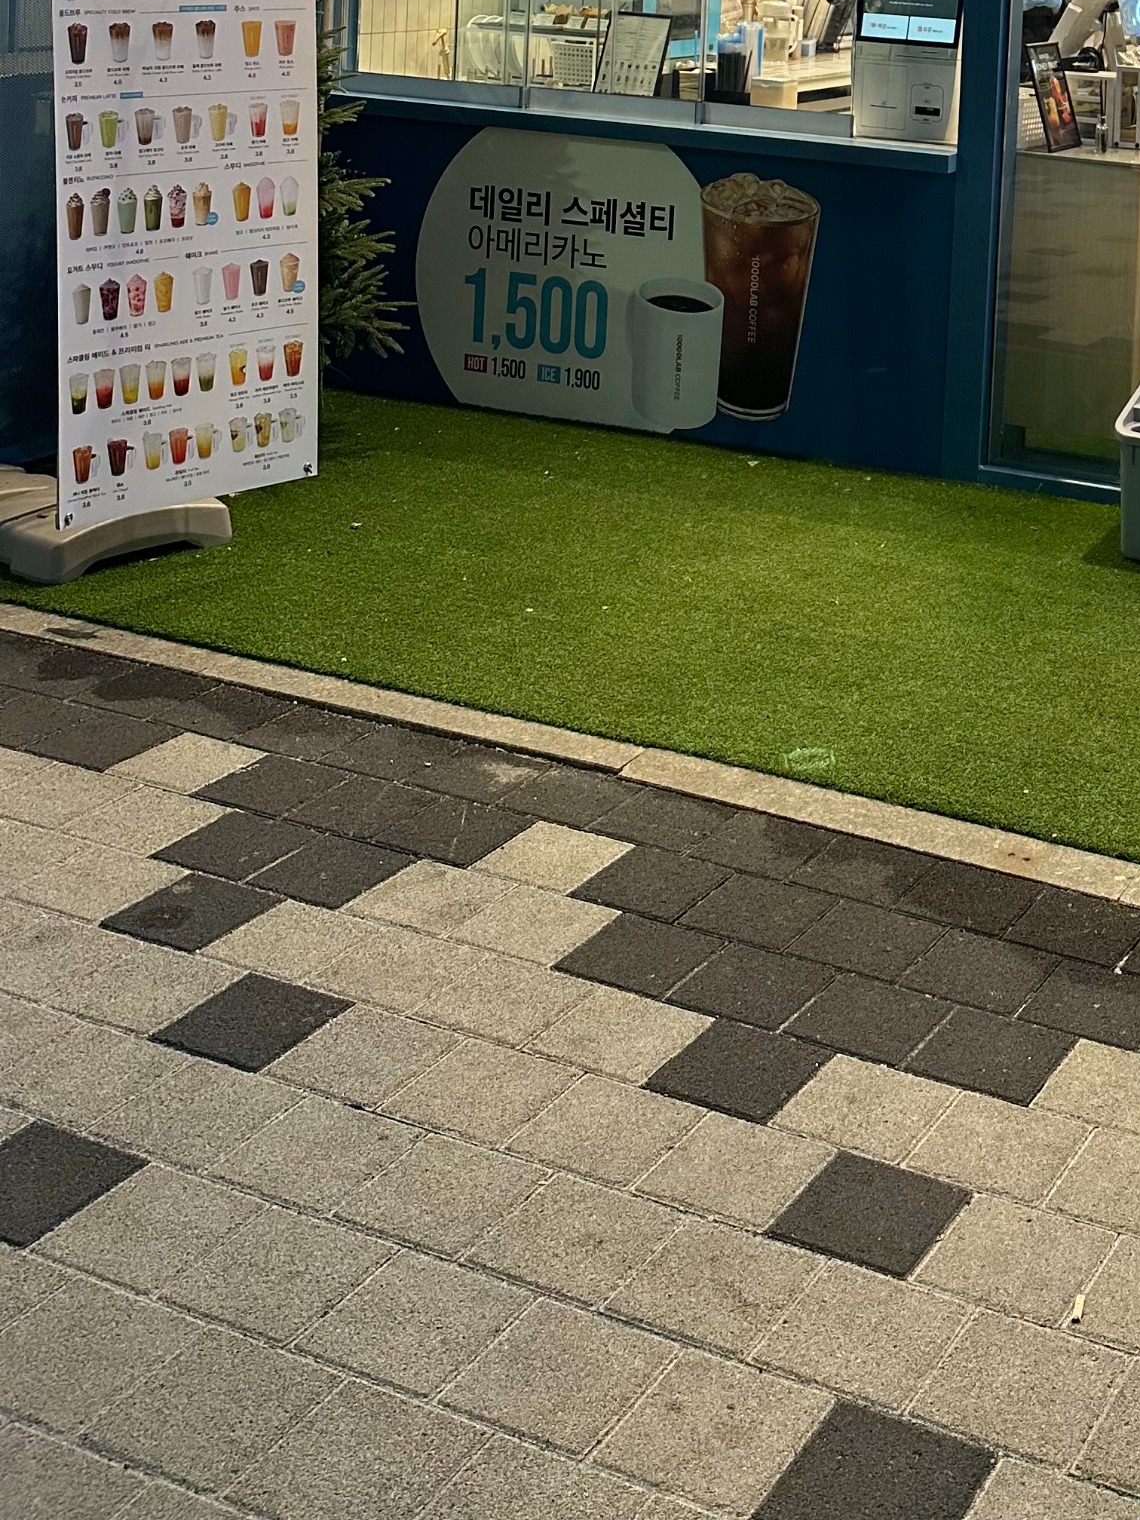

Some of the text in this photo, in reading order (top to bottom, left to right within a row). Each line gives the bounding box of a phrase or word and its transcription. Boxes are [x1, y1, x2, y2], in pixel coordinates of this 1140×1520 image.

[469, 185, 676, 241] 데일리 스페셜티
[468, 224, 608, 269] 아메리카노
[465, 267, 608, 359] 1,500
[747, 255, 760, 344] 10000LAB COFFEE
[467, 355, 486, 370] HOT
[541, 366, 558, 382] ICE
[673, 373, 682, 401] COFFEE
